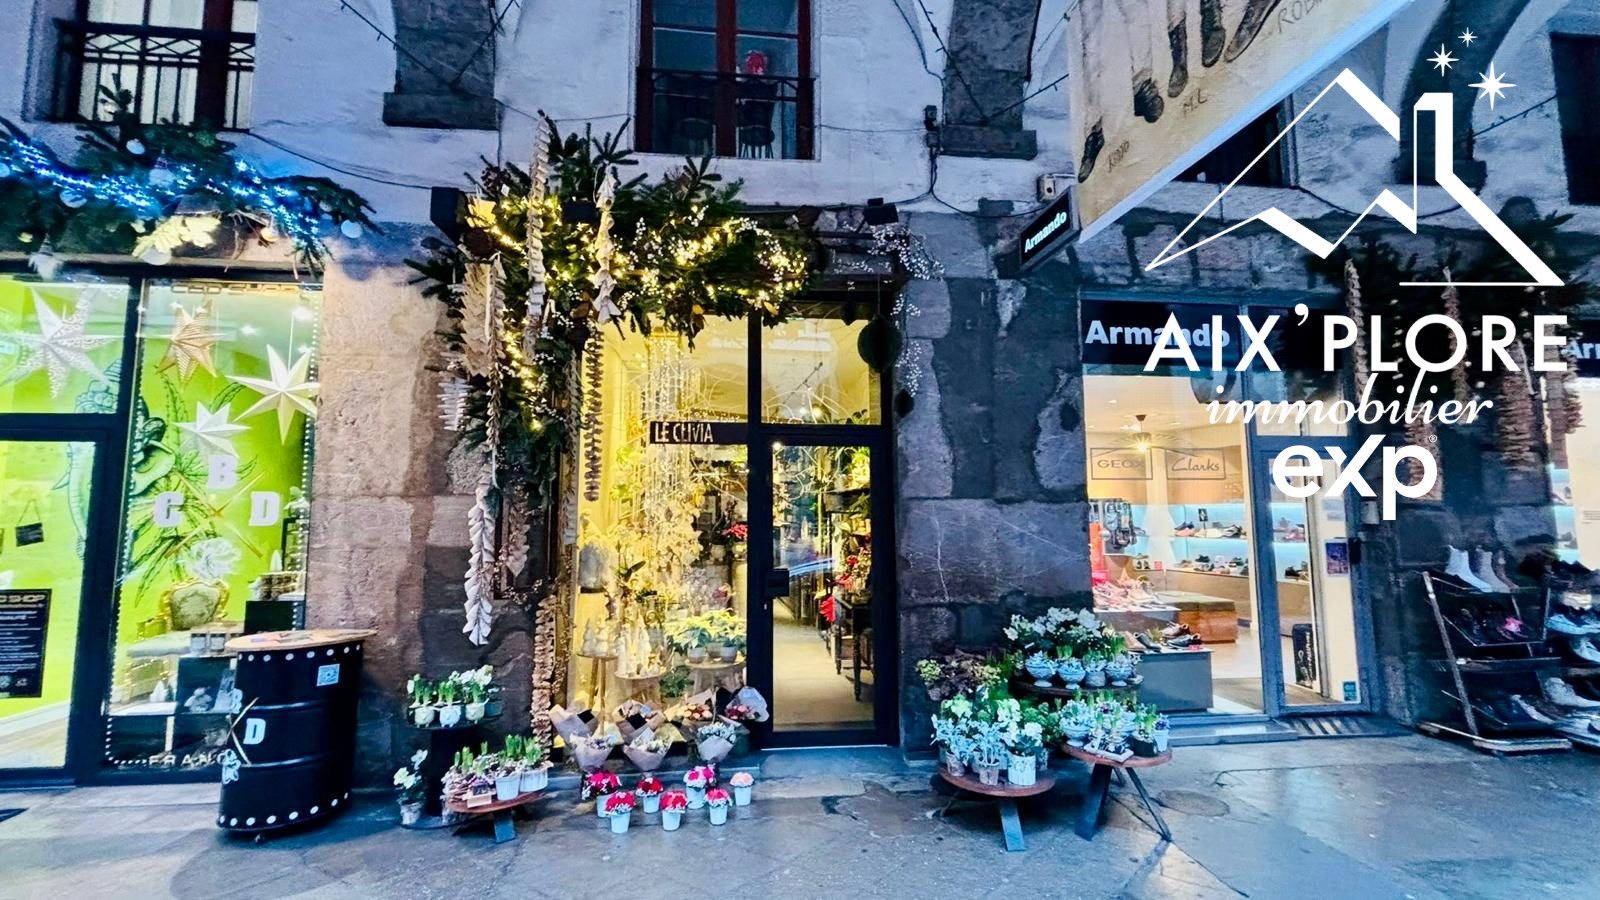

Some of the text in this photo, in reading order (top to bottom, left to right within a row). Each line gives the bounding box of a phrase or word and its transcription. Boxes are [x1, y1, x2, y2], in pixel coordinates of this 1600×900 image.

[1024, 211, 1067, 253] Armando
[1565, 340, 1600, 359] Ar
[655, 422, 669, 442] LE
[1097, 459, 1146, 469] GEOX
[1171, 456, 1220, 472] Clarks
